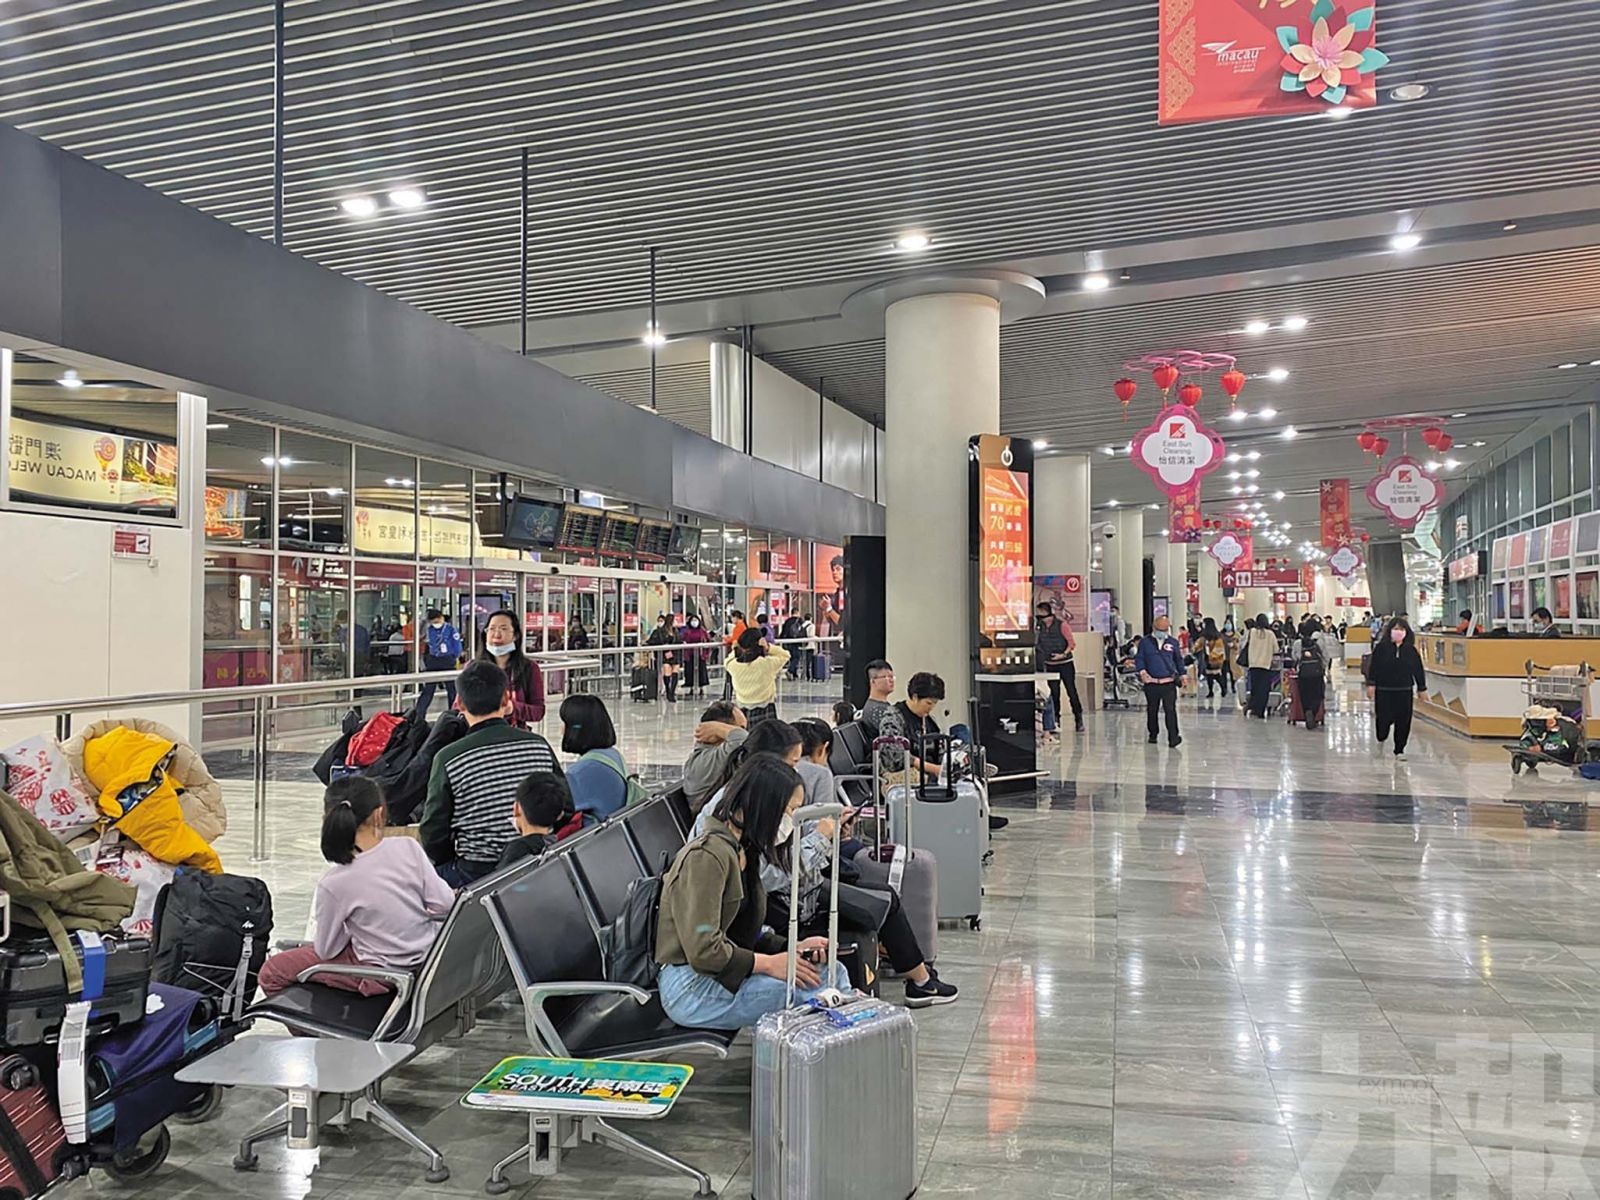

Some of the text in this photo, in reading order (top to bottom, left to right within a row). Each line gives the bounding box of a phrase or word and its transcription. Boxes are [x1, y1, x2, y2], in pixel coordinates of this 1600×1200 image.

[1217, 50, 1260, 62] macau
[1162, 447, 1191, 455] Cleaning
[990, 515, 1004, 531] 70
[990, 553, 1004, 568] 20
[498, 1073, 591, 1089] SOUTH
[546, 1086, 581, 1094] ASIA
